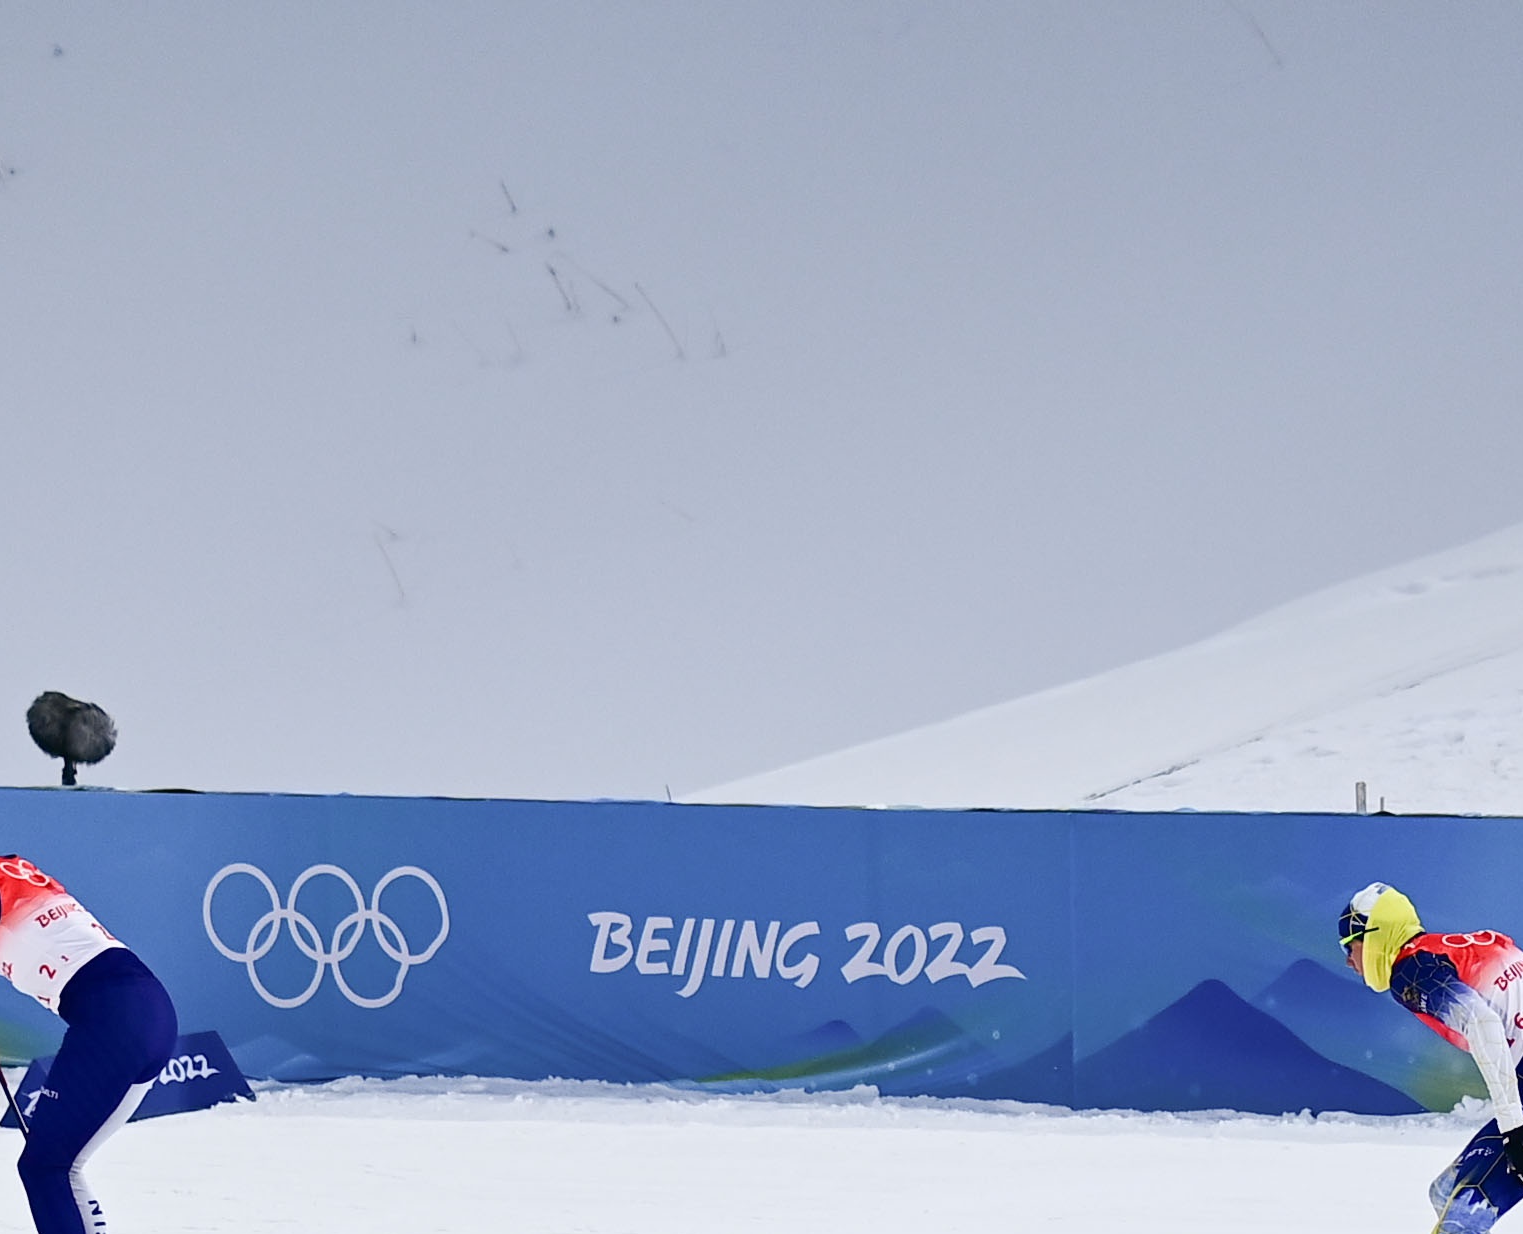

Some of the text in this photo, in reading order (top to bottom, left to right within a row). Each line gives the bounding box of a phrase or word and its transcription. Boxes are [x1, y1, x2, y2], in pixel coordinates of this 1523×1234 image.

[39, 964, 57, 980] 2
[587, 911, 1028, 998] BEIJING 2022
